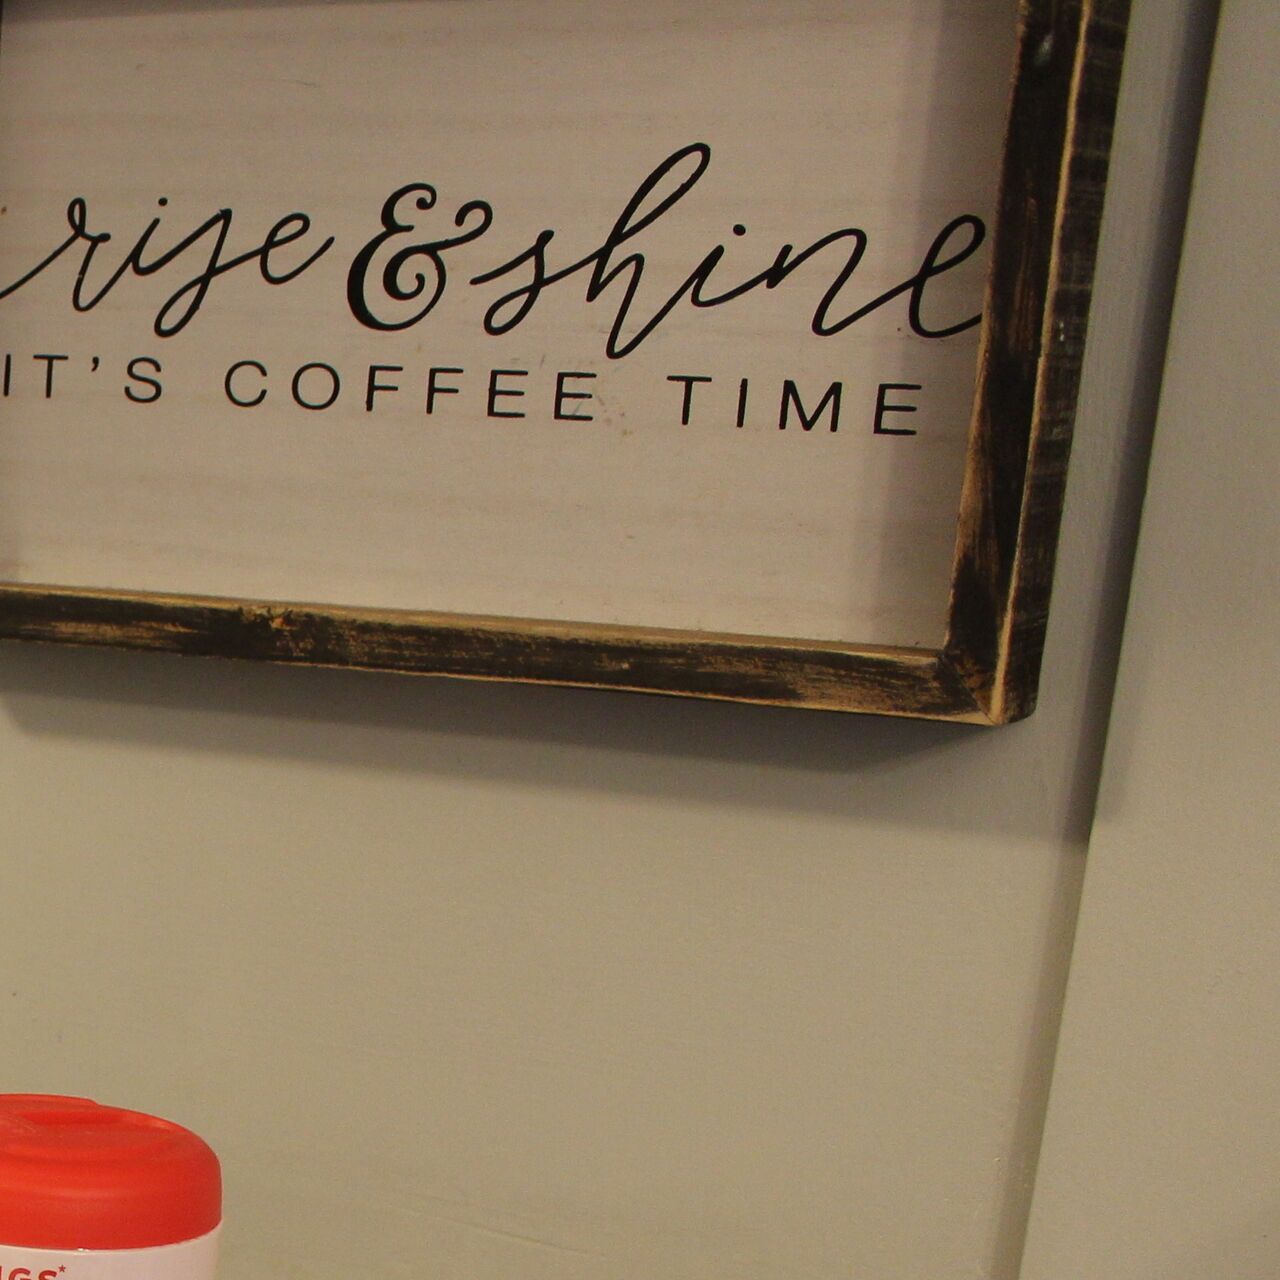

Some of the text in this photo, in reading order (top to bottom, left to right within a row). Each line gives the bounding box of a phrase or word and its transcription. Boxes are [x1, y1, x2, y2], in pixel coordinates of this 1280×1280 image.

[346, 182, 493, 332] &
[471, 142, 985, 359] shine
[1, 354, 923, 437] IT'S COFFEE TIME
